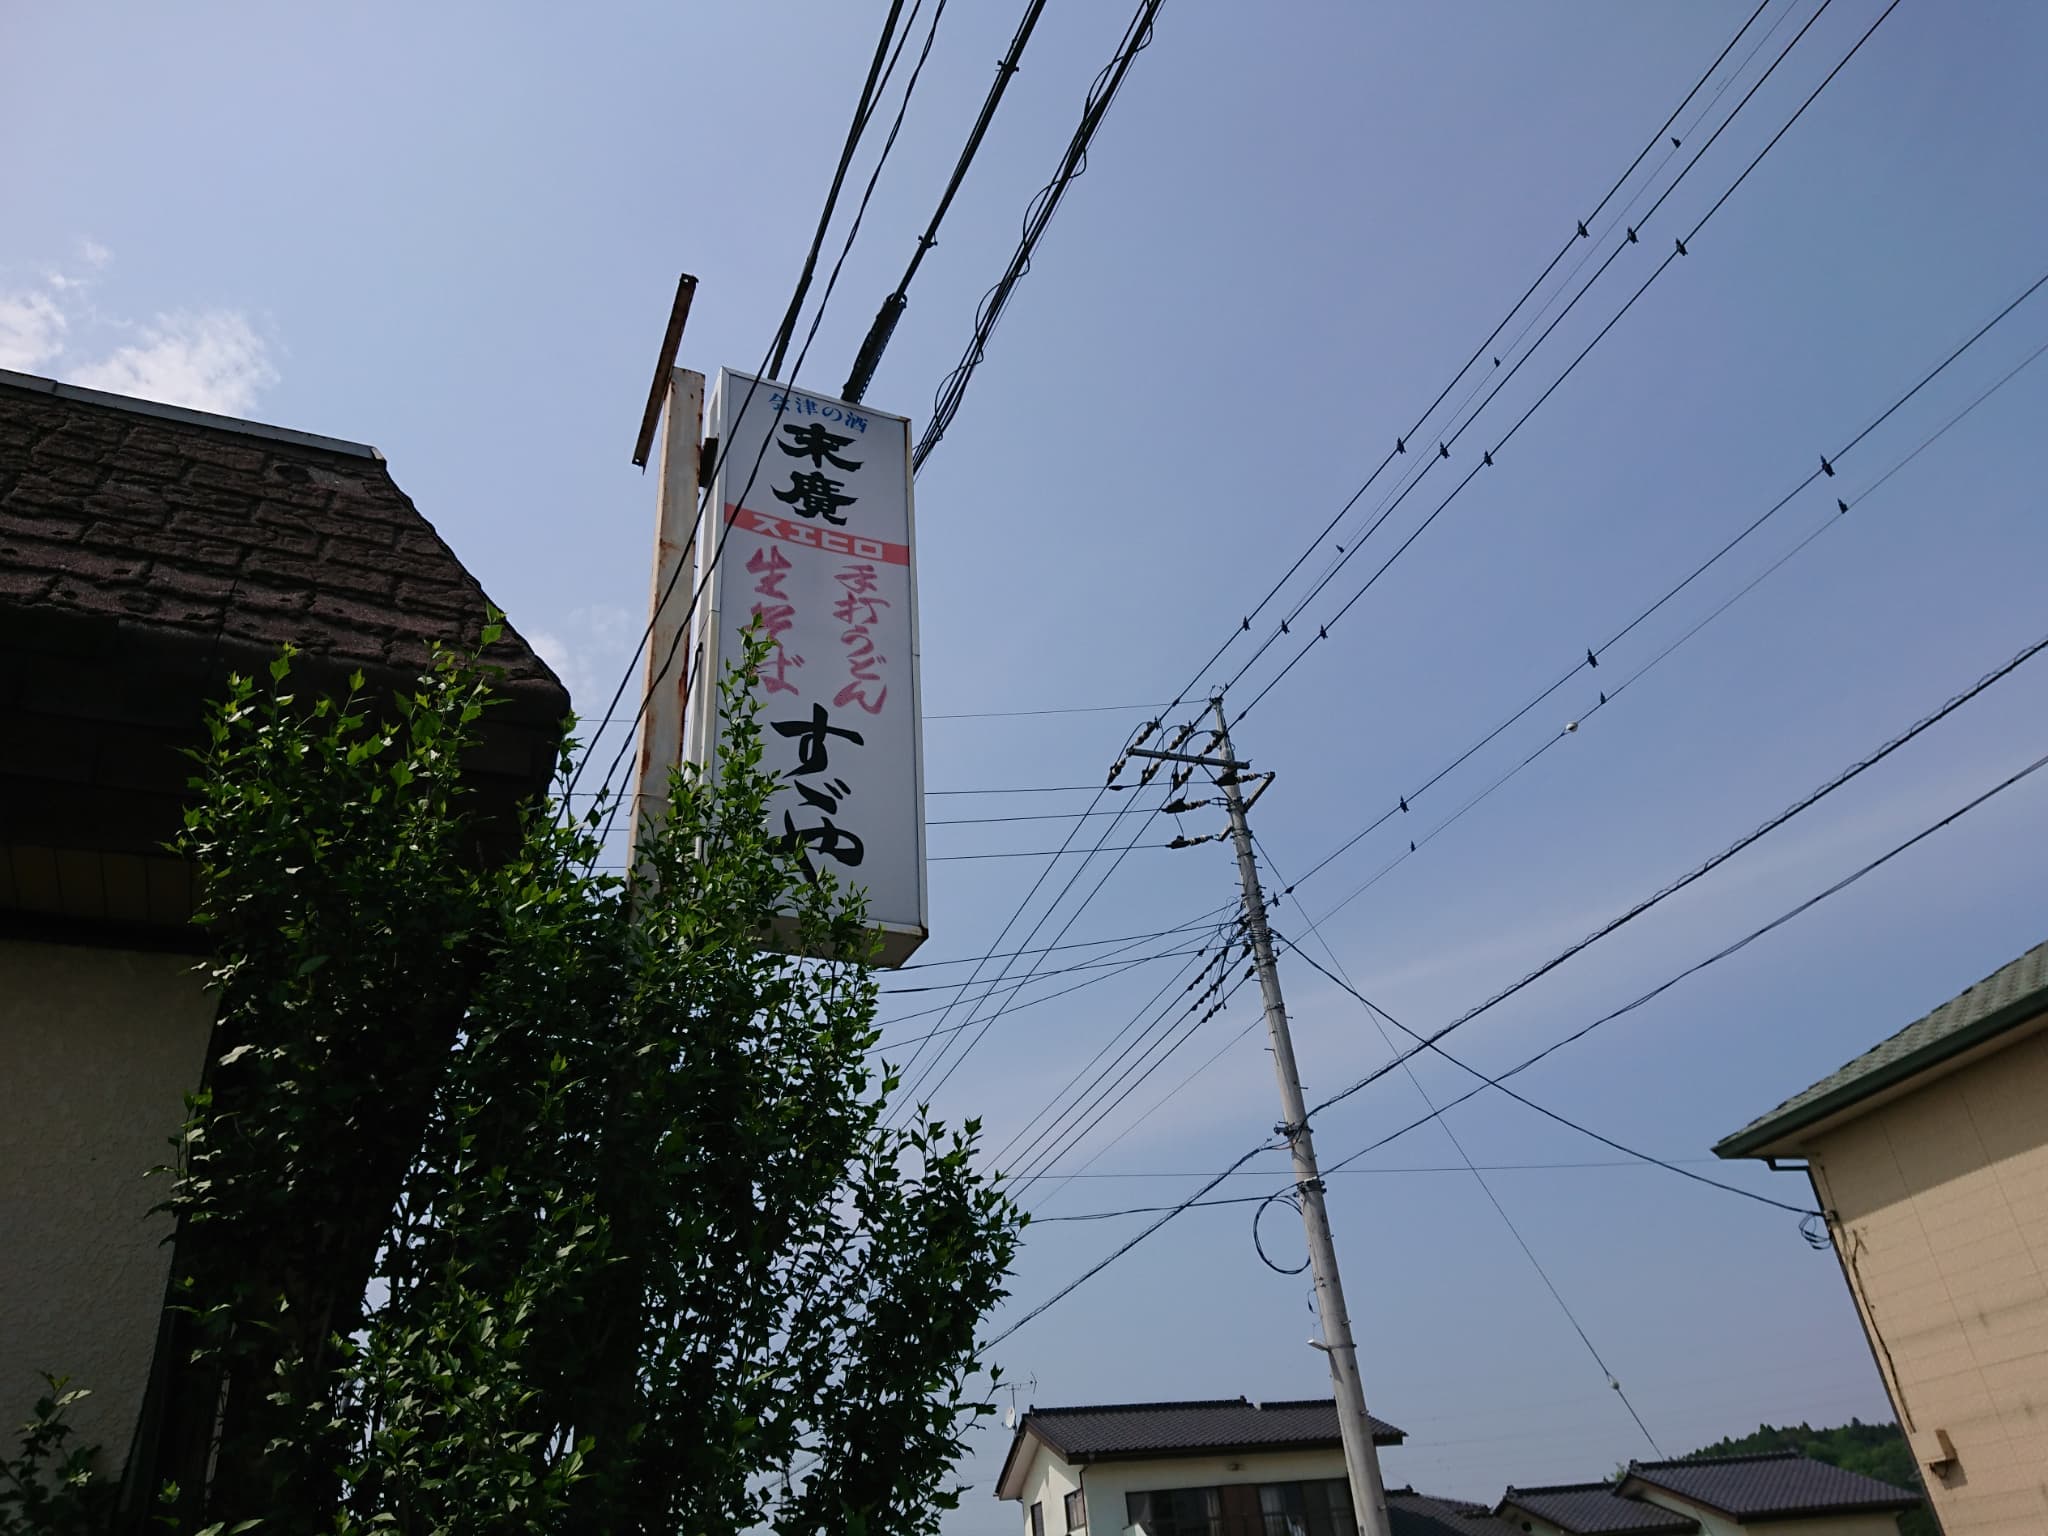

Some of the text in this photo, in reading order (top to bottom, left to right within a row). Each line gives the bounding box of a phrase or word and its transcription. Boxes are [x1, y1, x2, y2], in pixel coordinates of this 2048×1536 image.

[768, 393, 869, 434] 会津の酒
[752, 513, 884, 560] スエヒロ
